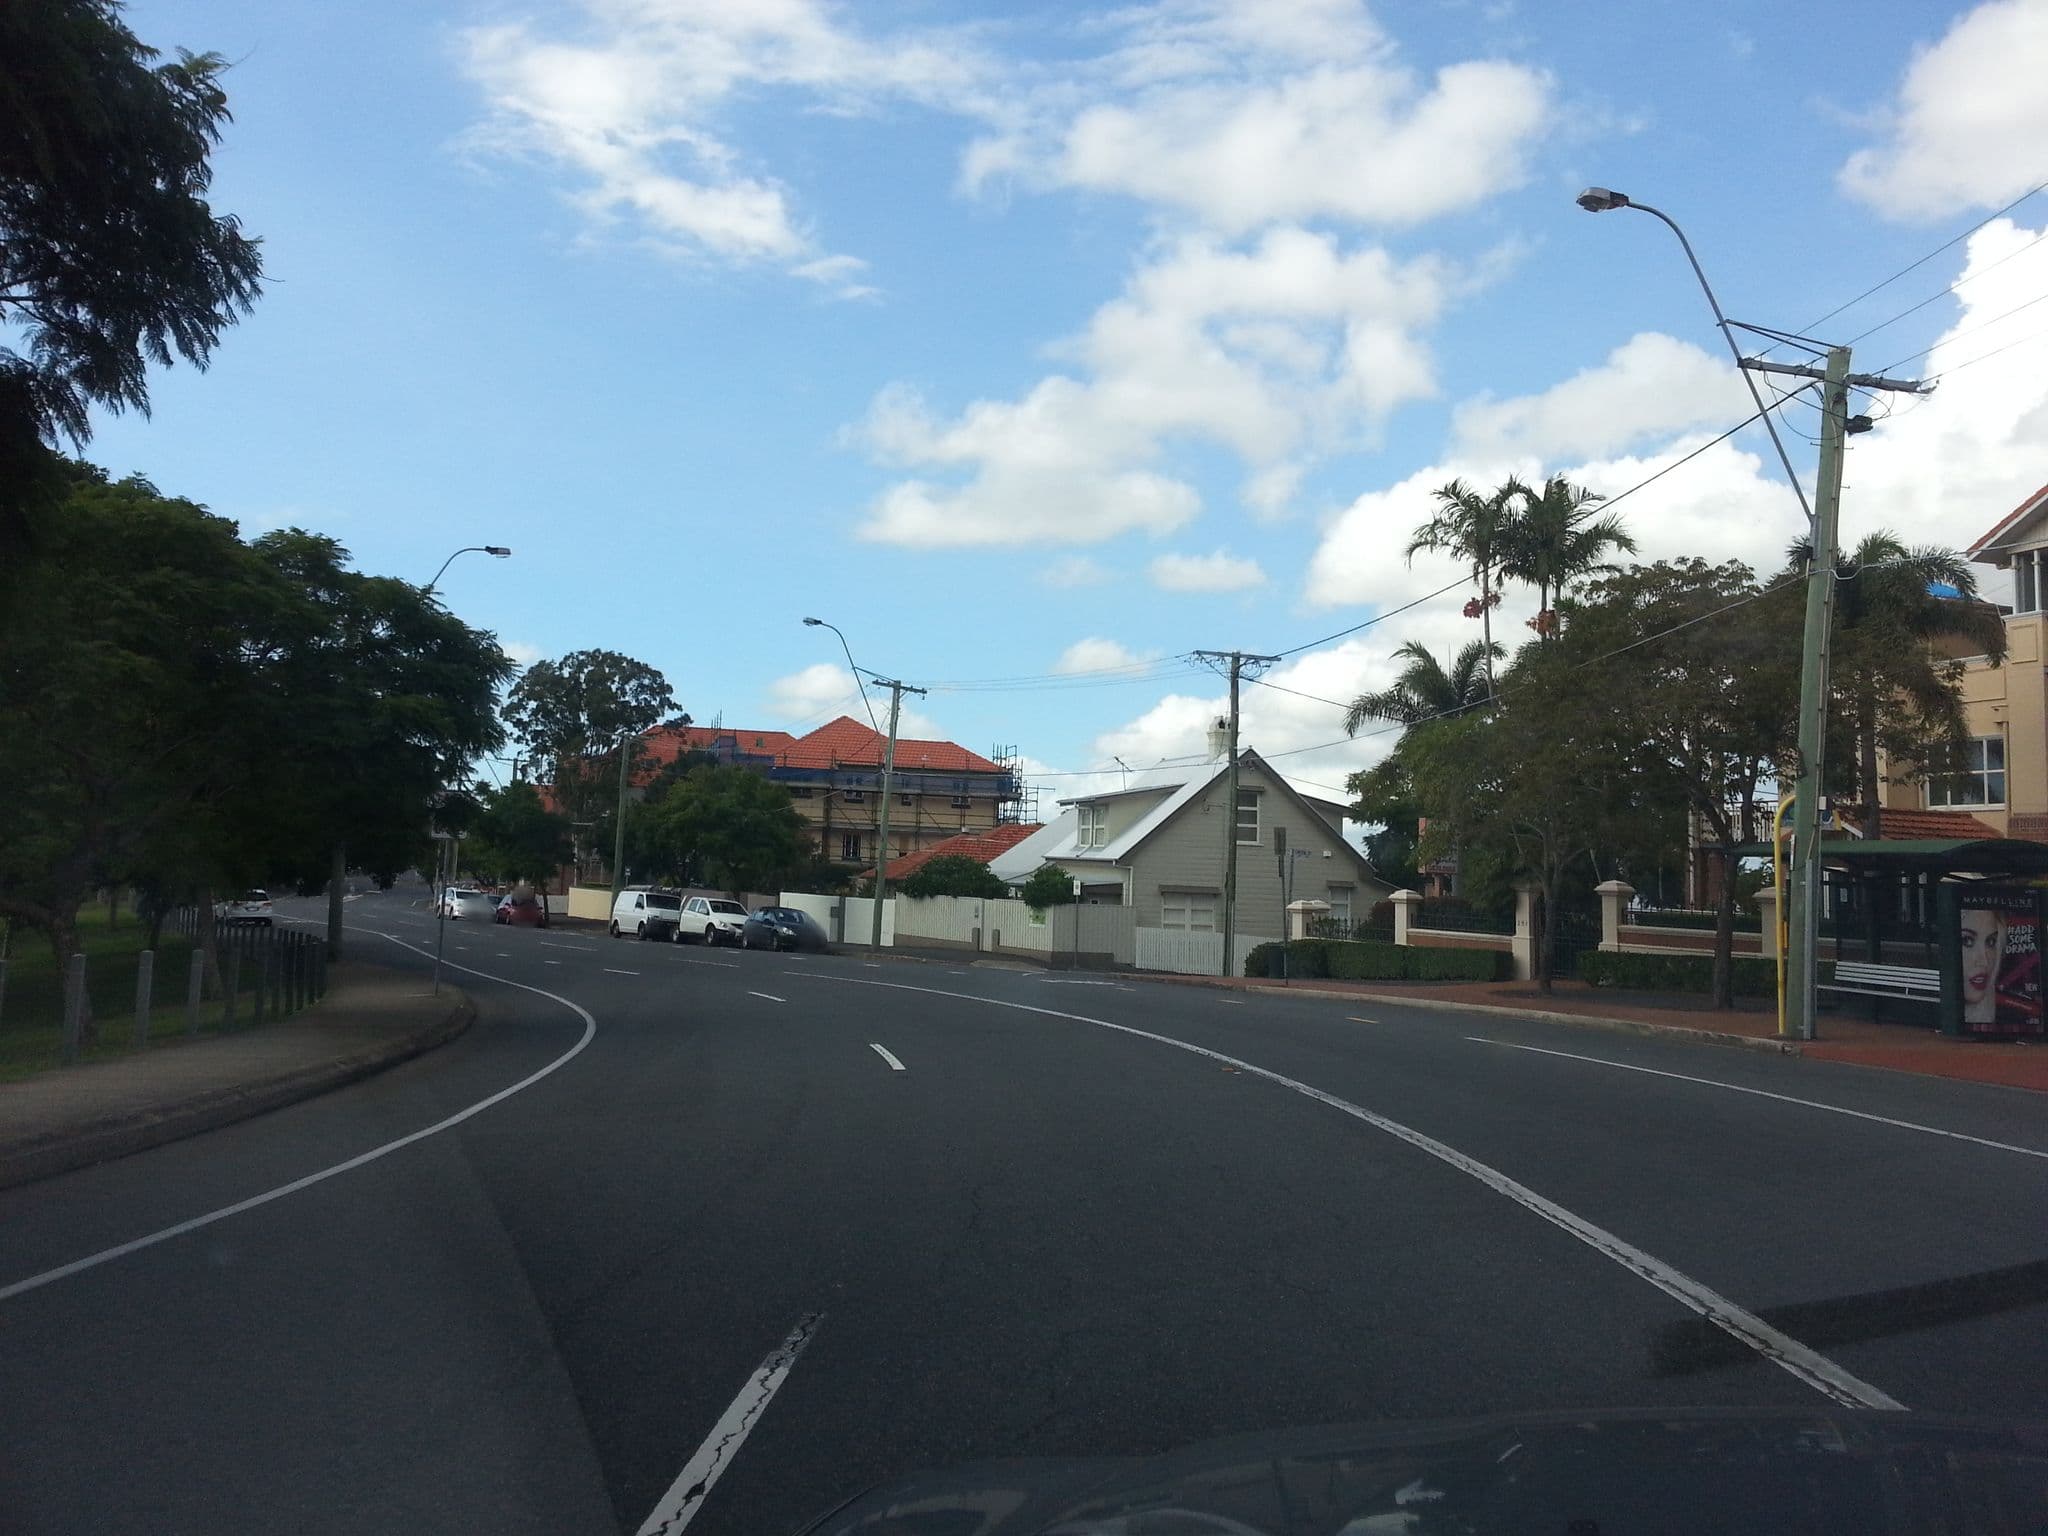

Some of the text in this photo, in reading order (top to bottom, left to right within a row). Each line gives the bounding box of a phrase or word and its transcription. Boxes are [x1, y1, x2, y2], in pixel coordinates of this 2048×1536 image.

[1962, 896, 2033, 905] MAYBELLINE
[2007, 924, 2035, 935] #ADD
[2009, 933, 2034, 945] SOME
[2005, 942, 2038, 954] DRAMA
